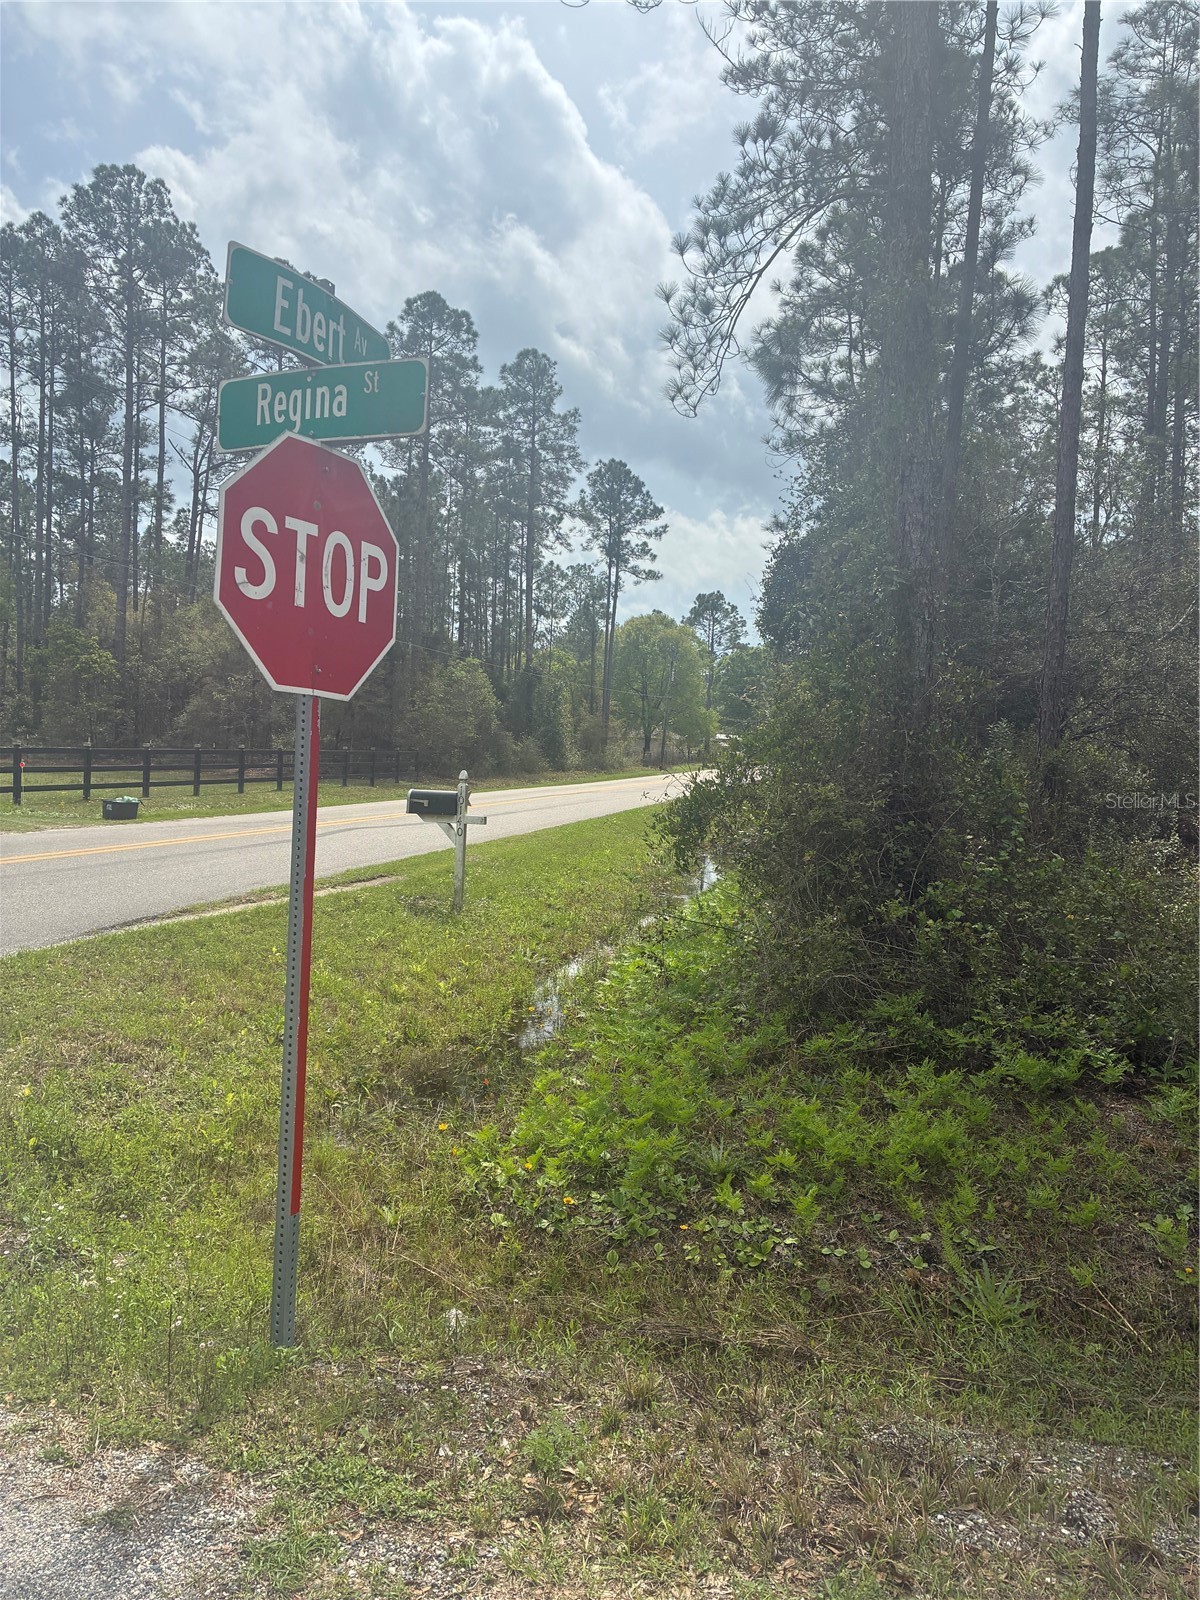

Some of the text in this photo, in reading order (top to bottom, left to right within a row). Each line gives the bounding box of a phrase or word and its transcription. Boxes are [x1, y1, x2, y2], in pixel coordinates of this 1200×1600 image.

[274, 276, 367, 363] Ebert Av
[256, 371, 379, 431] Regina St
[234, 506, 388, 623] STOP
